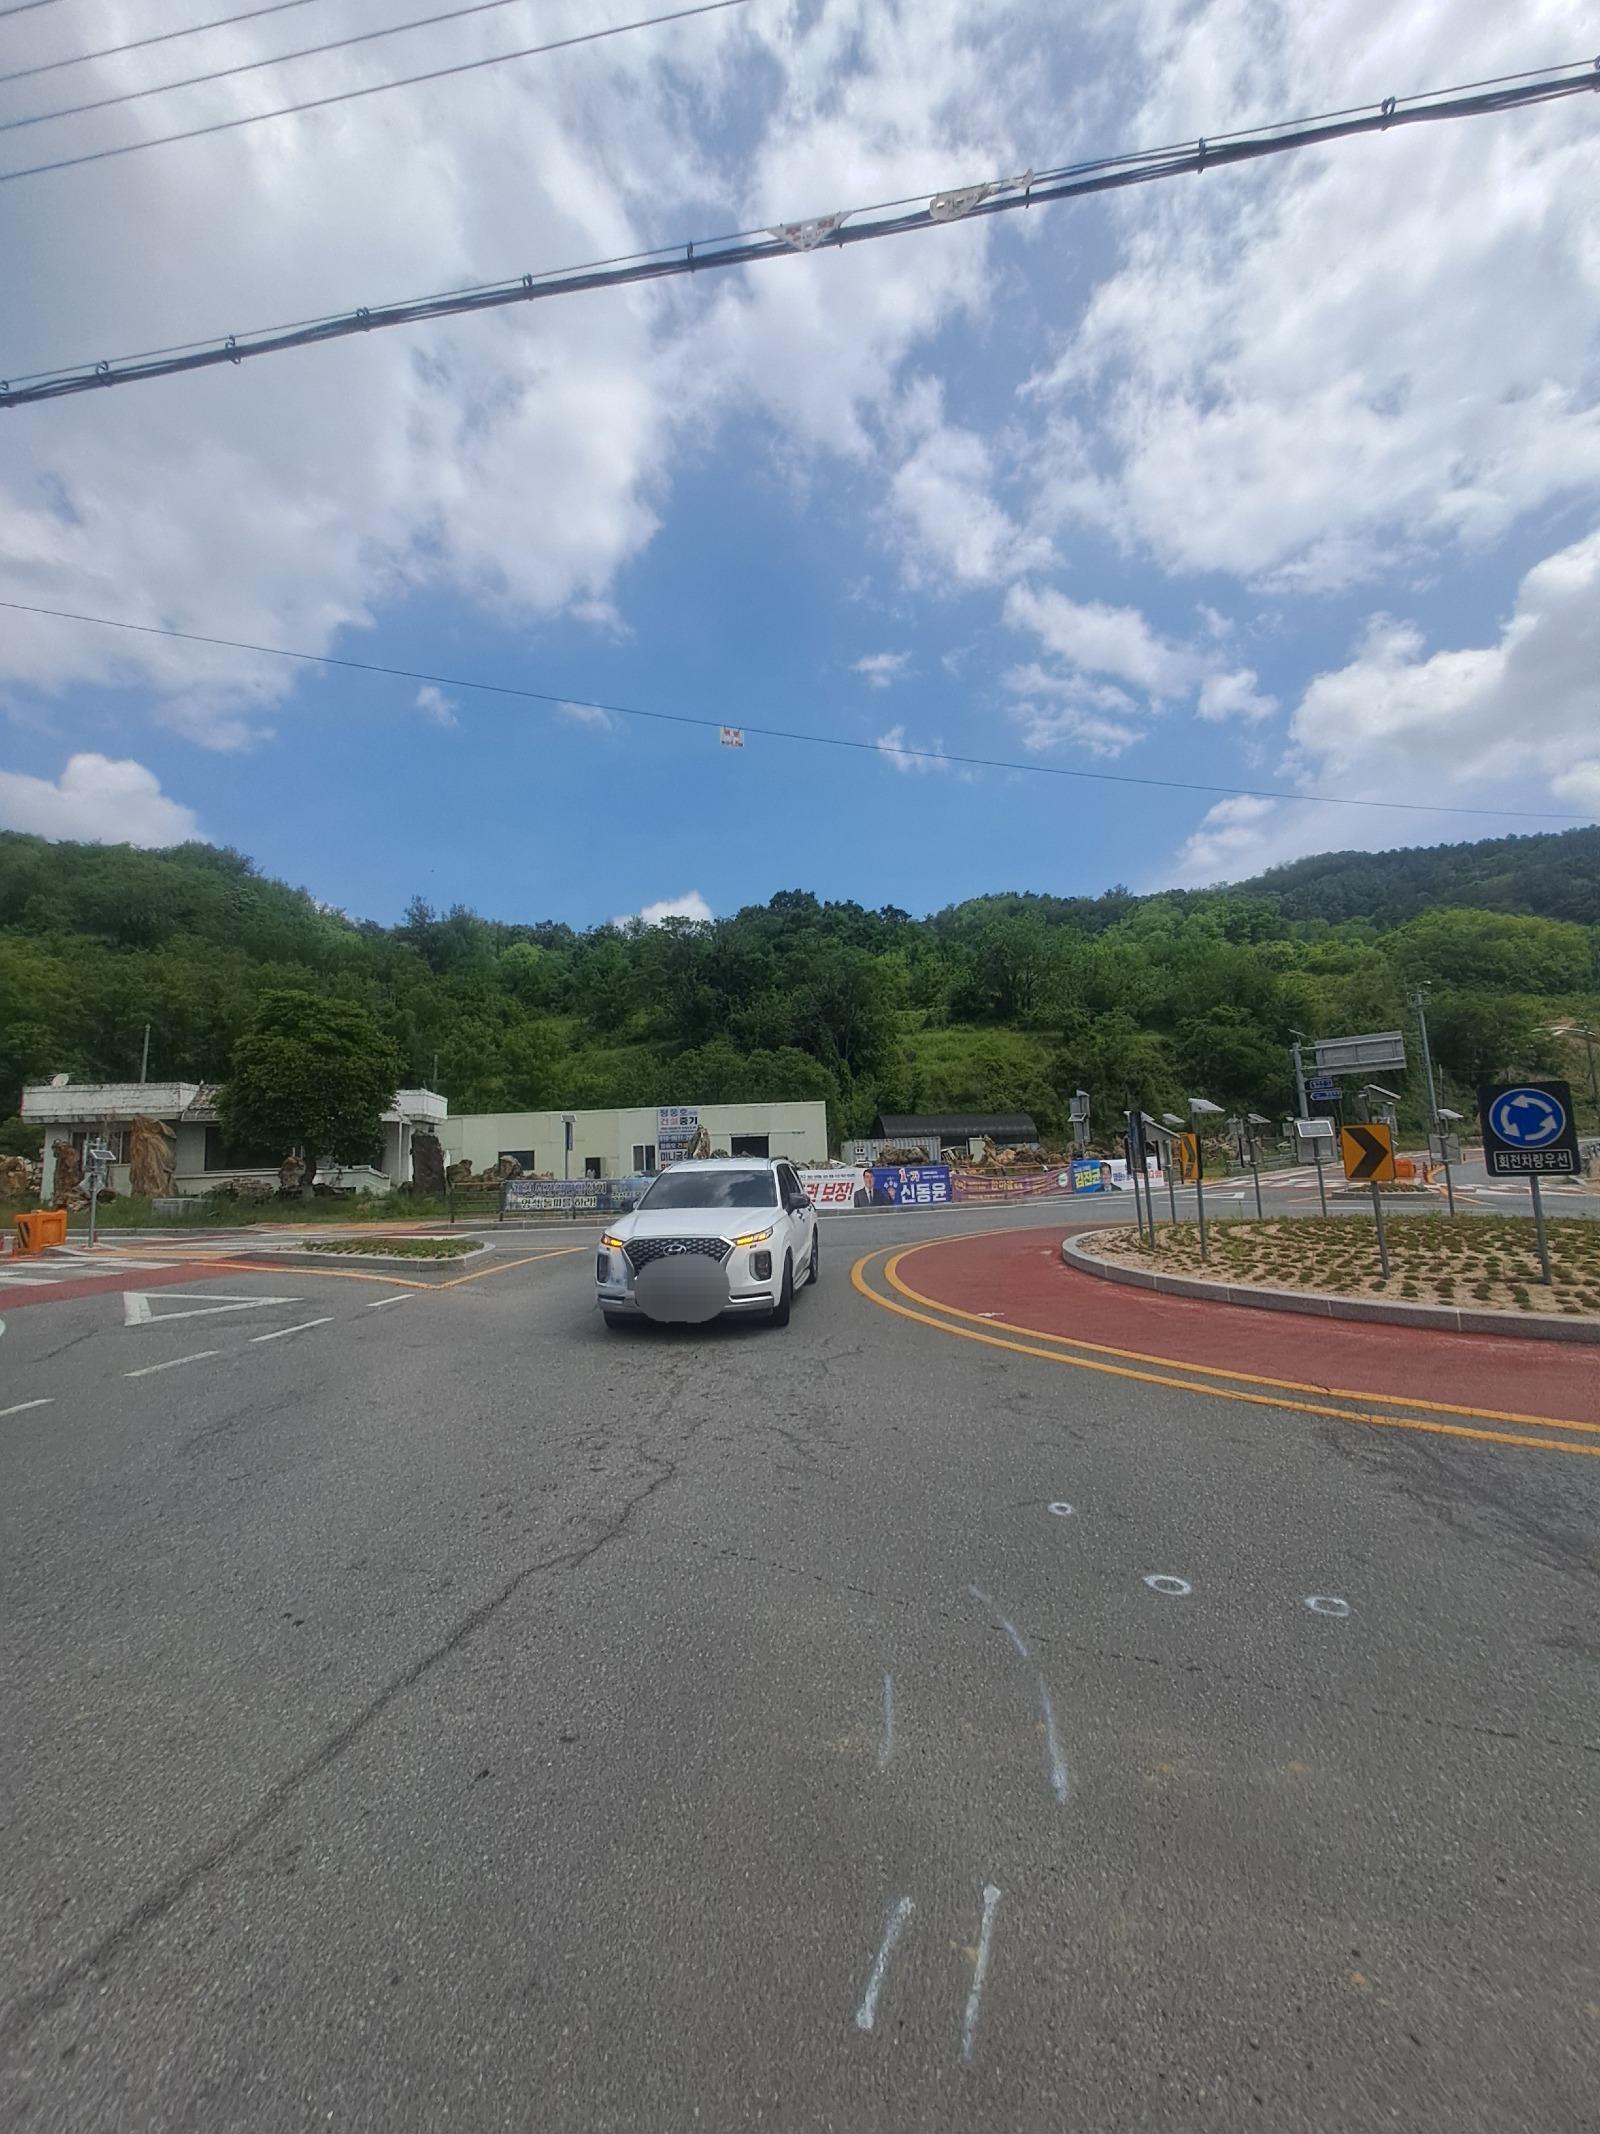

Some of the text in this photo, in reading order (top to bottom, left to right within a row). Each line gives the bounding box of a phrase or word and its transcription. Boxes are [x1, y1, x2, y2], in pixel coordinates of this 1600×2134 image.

[1498, 1152, 1569, 1168] 회전차량우선
[821, 1182, 855, 1202] 보장!
[574, 1197, 597, 1208] 하라!
